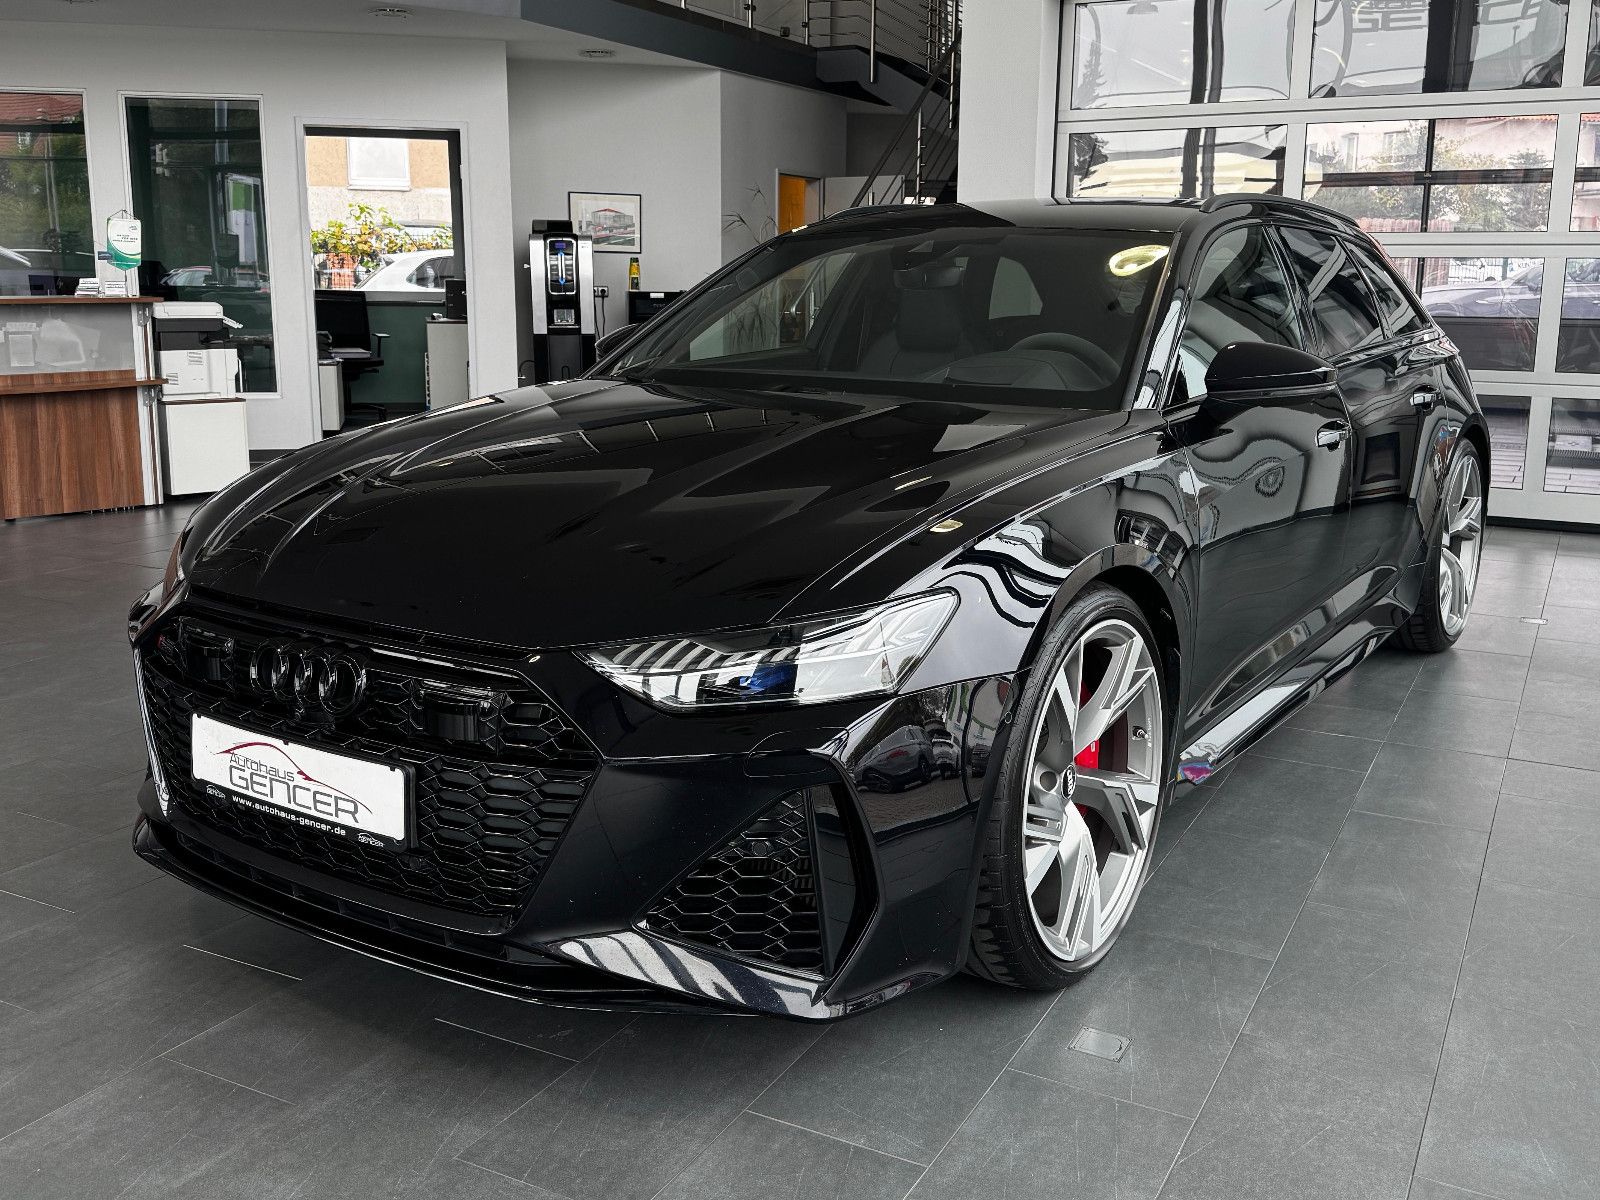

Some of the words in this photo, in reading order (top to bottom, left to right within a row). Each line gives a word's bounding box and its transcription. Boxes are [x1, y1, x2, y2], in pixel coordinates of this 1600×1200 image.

[230, 752, 295, 782] Autohaus
[229, 764, 359, 824] GENCER
[232, 795, 346, 836] www.autohaus-gencer.de
